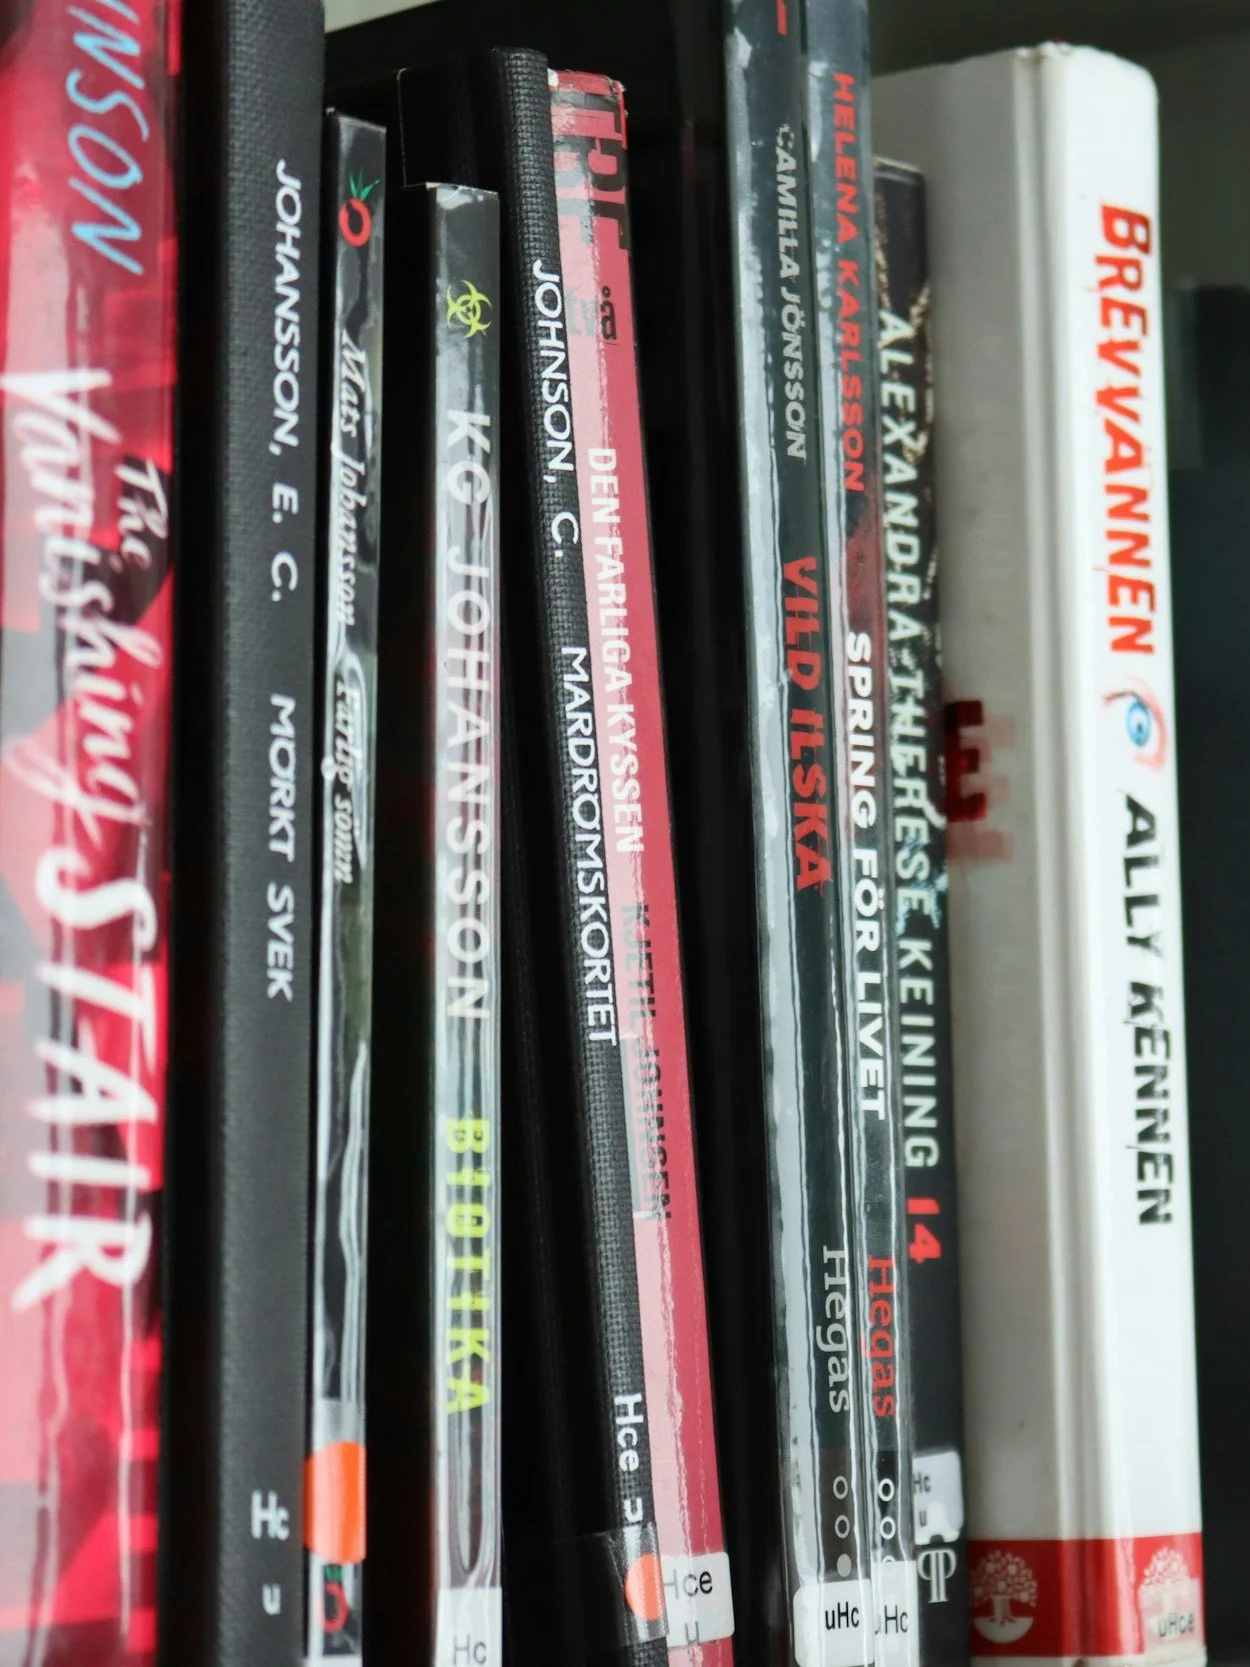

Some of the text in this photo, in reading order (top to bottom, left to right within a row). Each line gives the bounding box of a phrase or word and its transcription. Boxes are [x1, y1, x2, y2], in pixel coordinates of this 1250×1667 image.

[273, 159, 303, 458] JOHANSSON,
[774, 123, 808, 464] CAMILLA JÖNSSON
[833, 71, 866, 493] HELENA KARLSSON
[338, 330, 366, 439] Mats
[532, 260, 576, 485] JOHNSON,
[114, 457, 169, 574] The
[270, 558, 299, 603] C.
[271, 484, 300, 526] E.
[331, 444, 368, 628] Johansson
[549, 510, 580, 559] C.
[2, 369, 162, 846] Vanishing
[783, 555, 832, 893] VILD ILSKA
[332, 793, 361, 885] sömn
[445, 409, 491, 1416] KG JOHANSSON BIOTIKA
[588, 447, 673, 1221] DEN FARLIGA KYSSEN KJETIL JOHNSEN
[846, 631, 886, 1121] SPRING FÖR LIVET
[265, 881, 295, 1002] SVEK
[1121, 793, 1176, 1227] ALLY KENNEN
[13, 847, 158, 1312] STAIR
[897, 936, 940, 1169] KEINING
[906, 1197, 942, 1265] 14
[815, 1244, 850, 1414] Hegas
[861, 1255, 898, 1418] Hegas
[612, 1393, 644, 1473] Hce
[453, 1634, 488, 1667] Hc
[824, 1601, 861, 1631] uHc
[1156, 1610, 1196, 1638] uHce
